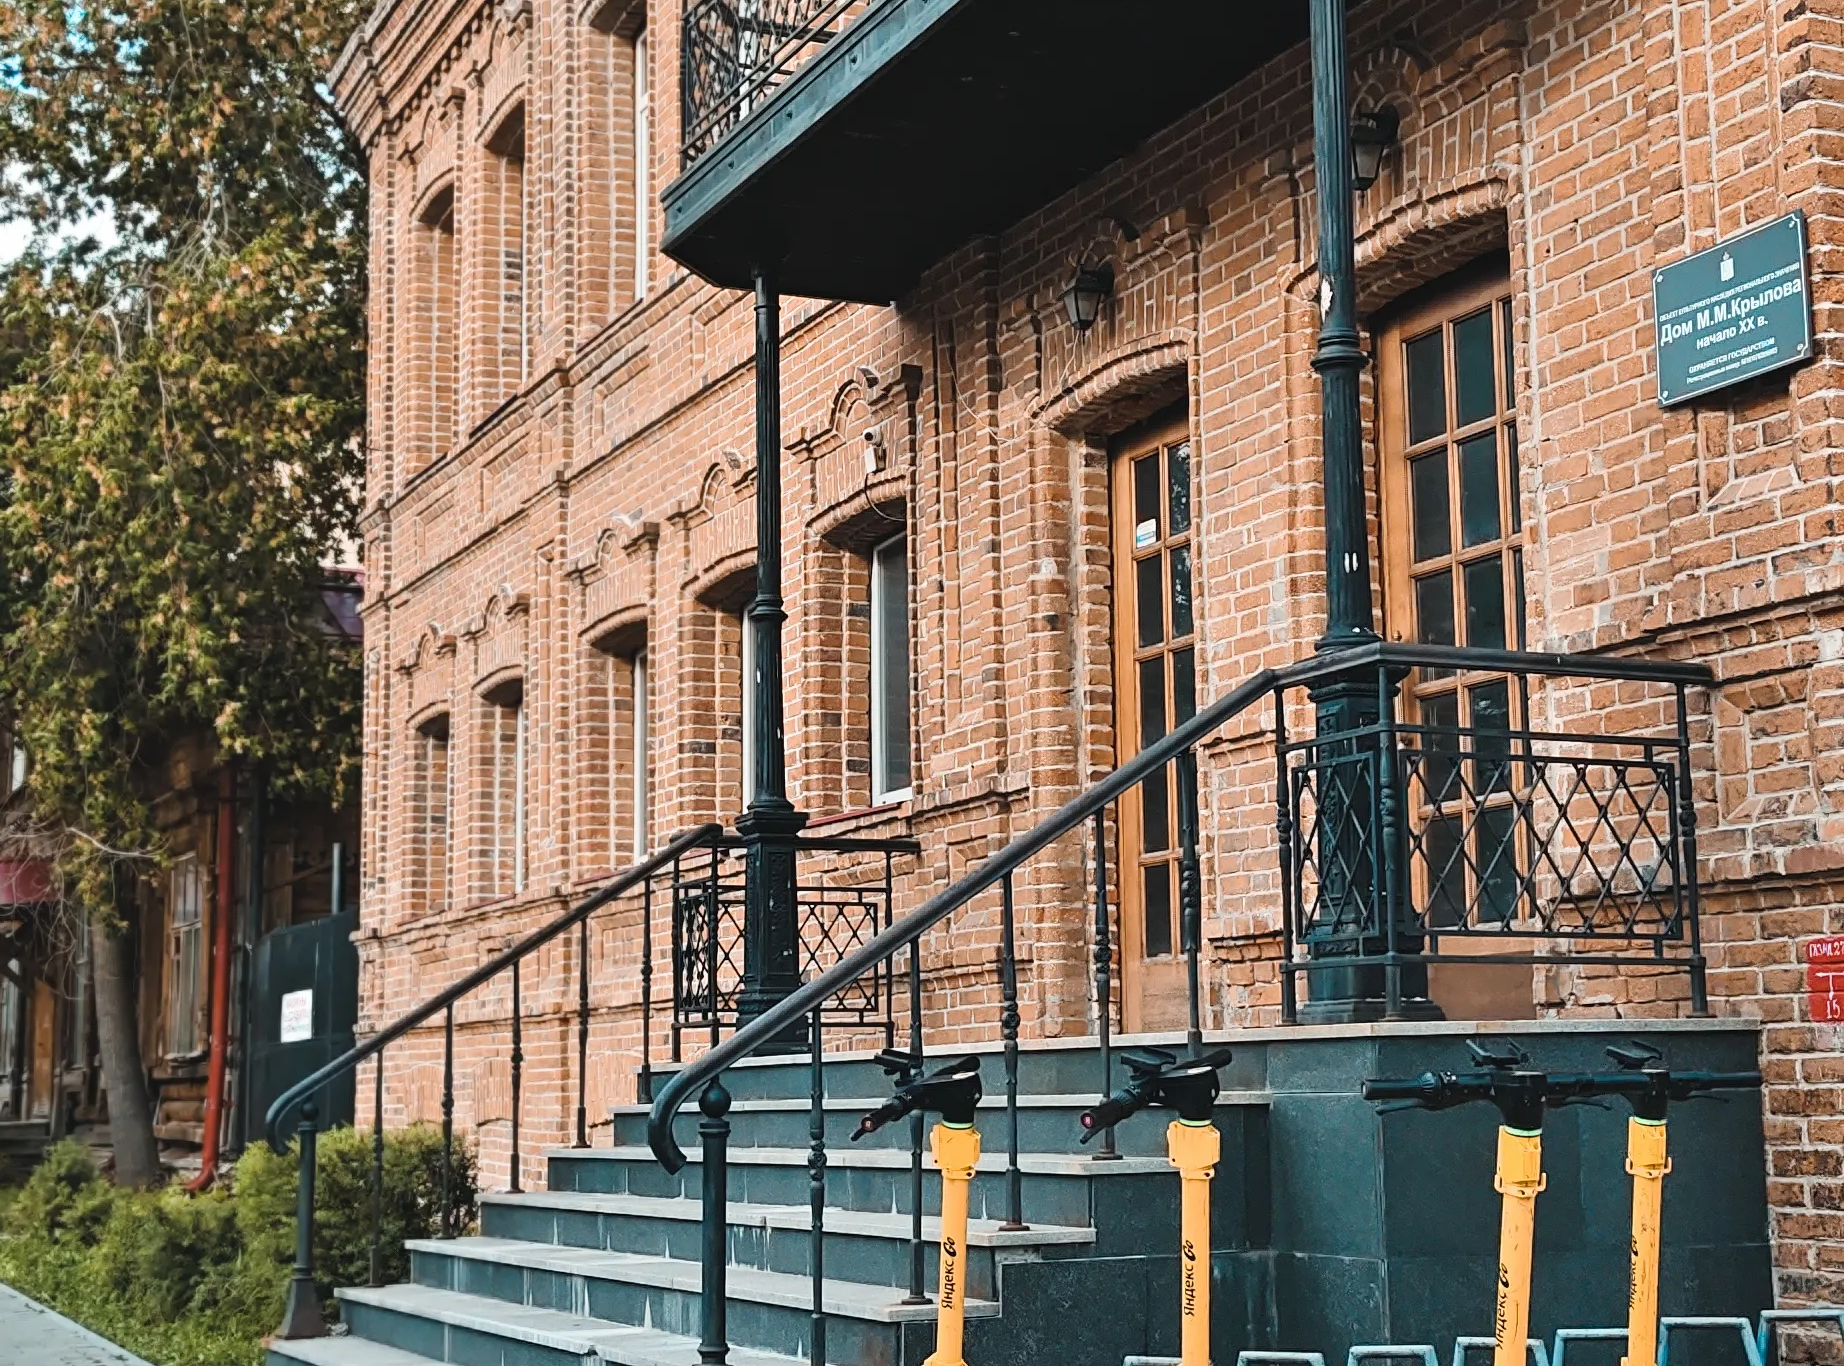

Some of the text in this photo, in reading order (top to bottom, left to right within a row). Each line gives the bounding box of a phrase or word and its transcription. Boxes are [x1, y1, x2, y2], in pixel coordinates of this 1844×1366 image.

[1660, 278, 1802, 346] Дом М.М.Крылова
[1696, 326, 1737, 350] начало
[1827, 999, 1840, 1019] 15
[942, 1237, 957, 1309] Яндекс Go
[1183, 1240, 1196, 1317] Яндекс Go
